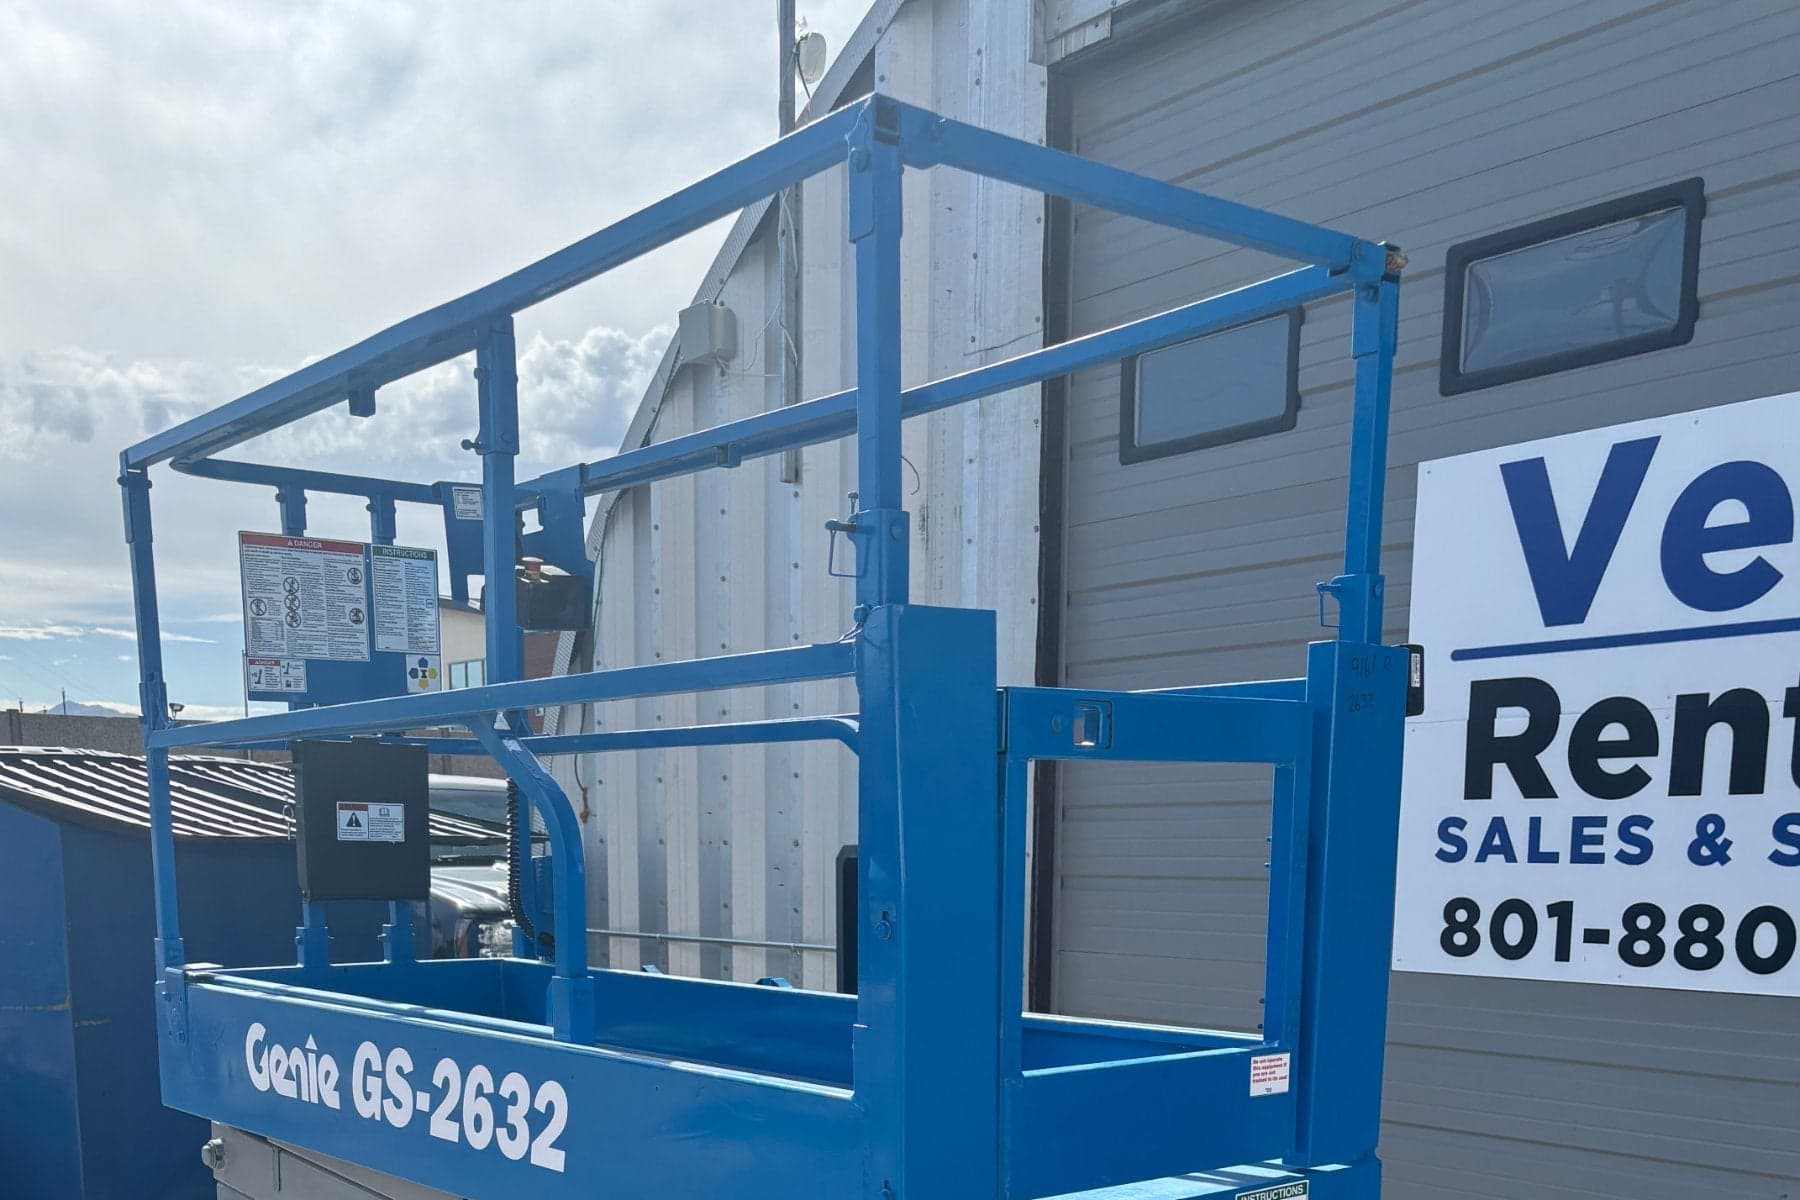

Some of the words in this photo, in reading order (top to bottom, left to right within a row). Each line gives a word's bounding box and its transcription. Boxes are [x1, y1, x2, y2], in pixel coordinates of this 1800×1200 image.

[382, 547, 427, 559] INSTRUCTIONS
[1500, 435, 1795, 627] Ve
[1434, 814, 1655, 866] SALES
[1686, 813, 1734, 867] &
[1439, 897, 1797, 976] 801-880
[245, 1022, 340, 1110] Genie
[352, 1041, 569, 1173] GS-2632
